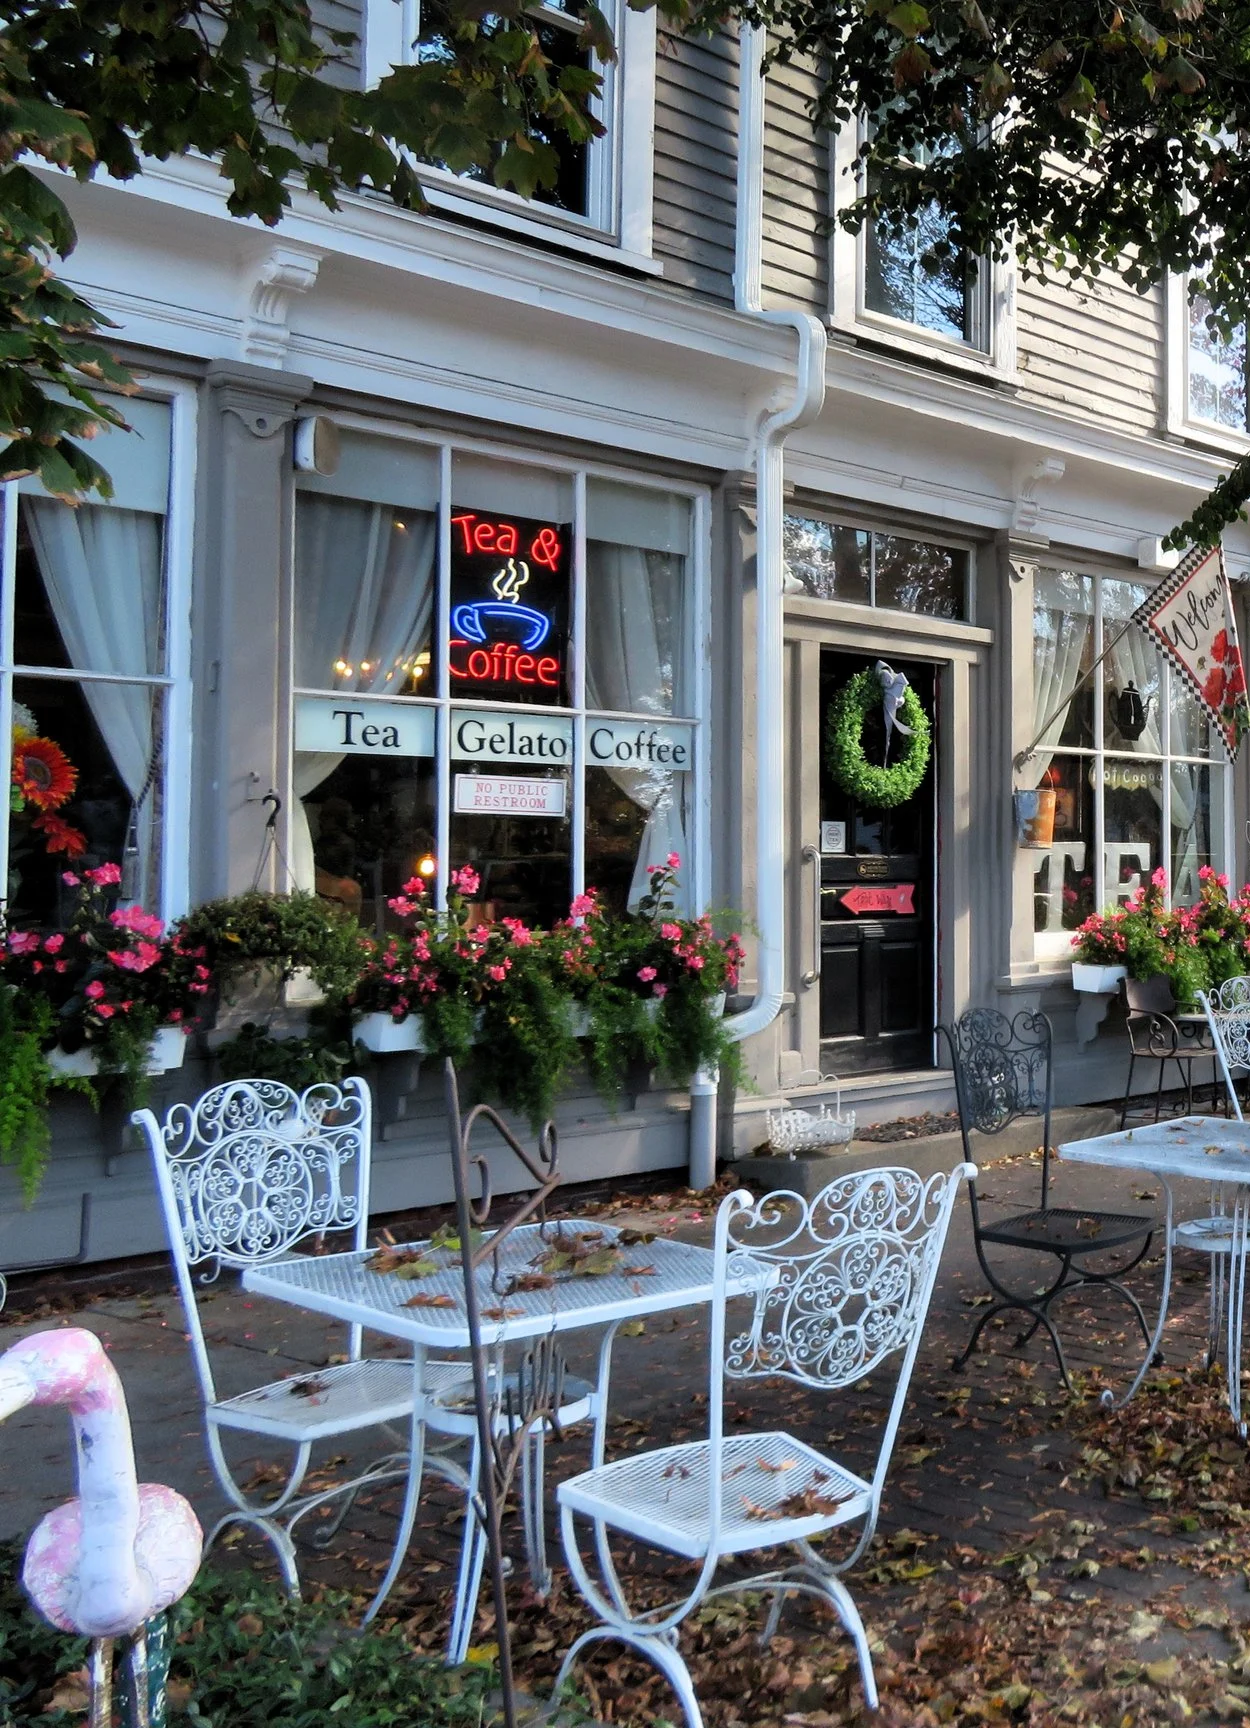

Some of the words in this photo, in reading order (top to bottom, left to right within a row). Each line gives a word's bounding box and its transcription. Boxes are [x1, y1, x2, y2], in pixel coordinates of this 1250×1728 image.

[450, 514, 518, 555] Tea
[531, 527, 561, 571] &
[447, 640, 559, 685] Coffee
[332, 710, 401, 748] Tea
[456, 719, 568, 759] Gelato
[590, 727, 687, 764] Coffee
[474, 795, 547, 809] RESTROOM
[475, 782, 492, 794] NO
[499, 783, 549, 796] PUBLIC
